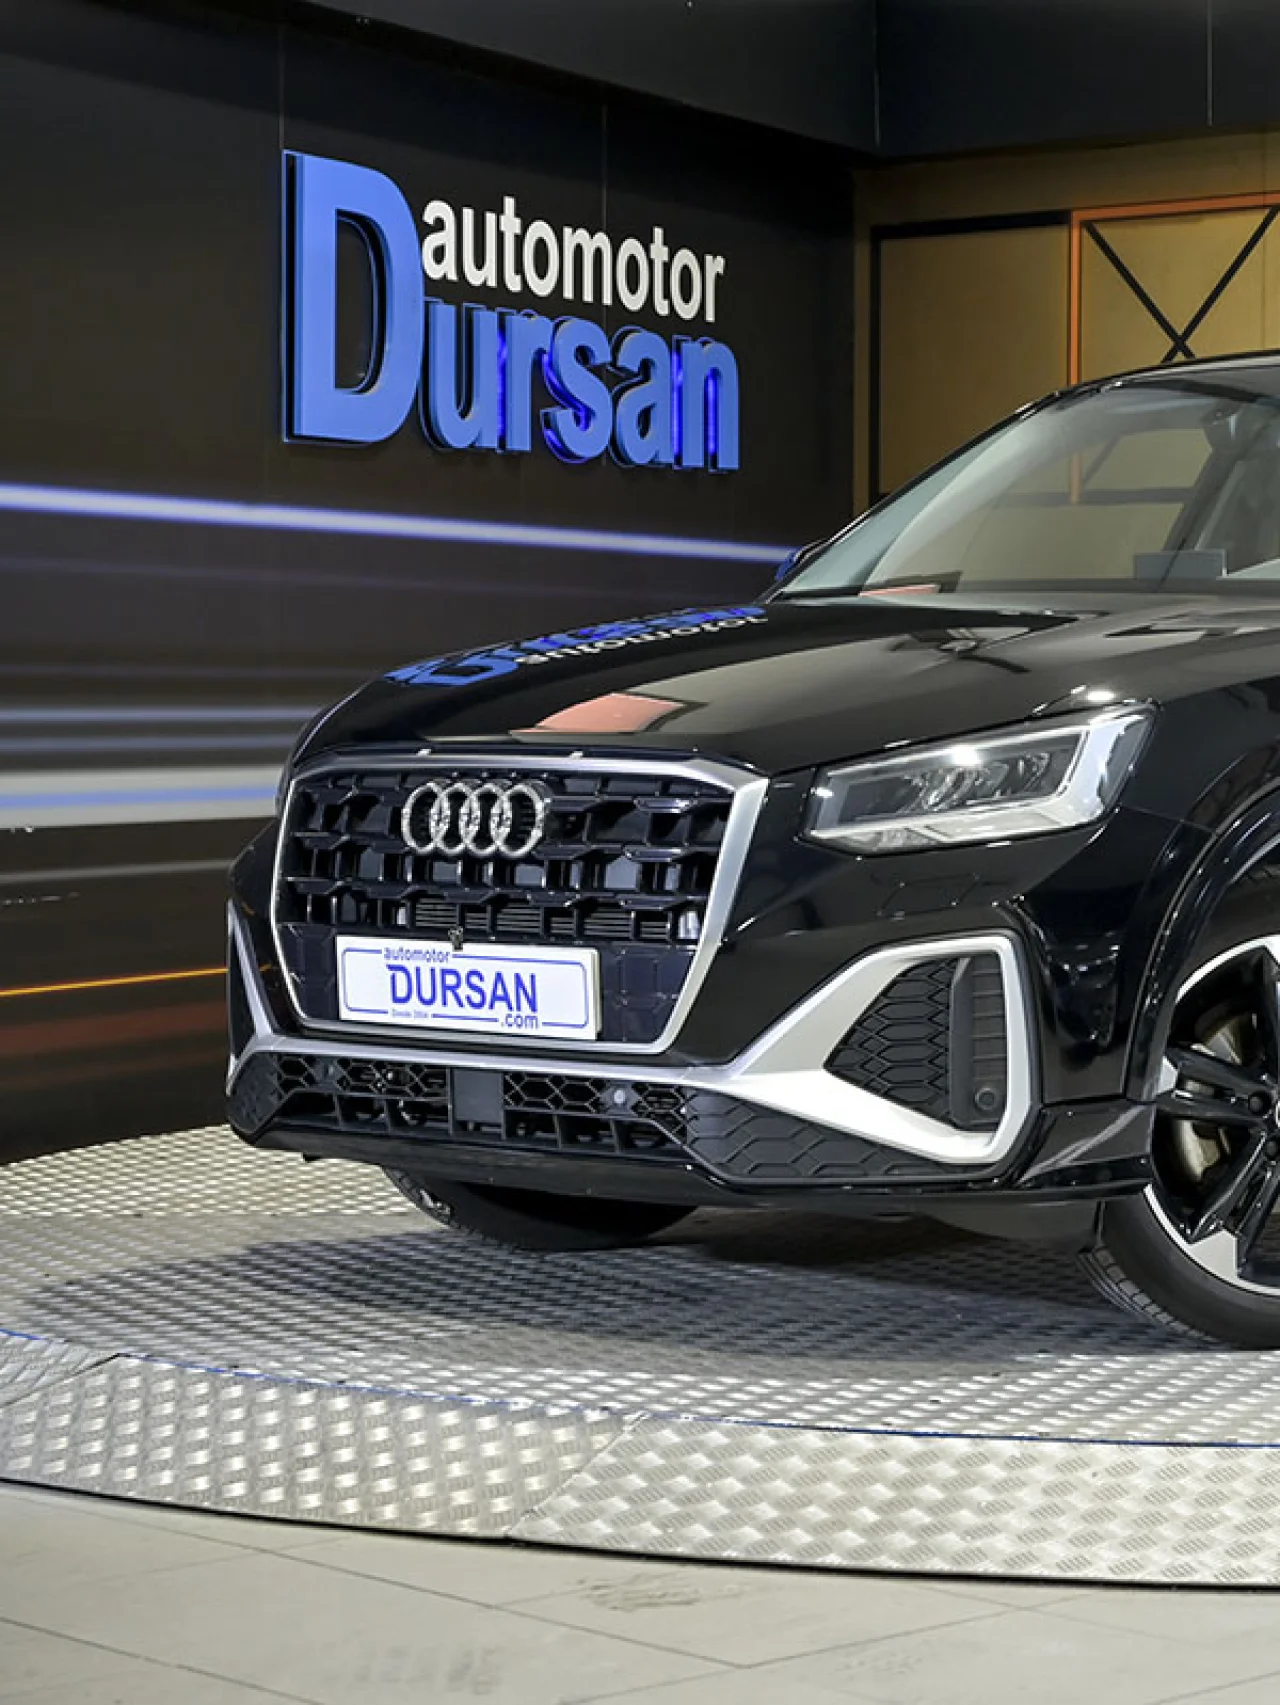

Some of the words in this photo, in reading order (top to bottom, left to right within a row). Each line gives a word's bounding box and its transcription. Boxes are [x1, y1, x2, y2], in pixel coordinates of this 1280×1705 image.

[421, 197, 726, 323] automotor
[283, 149, 740, 471] Dursan
[384, 947, 450, 963] automotor
[386, 964, 538, 1013] DURSAN
[500, 1013, 540, 1030] .com
